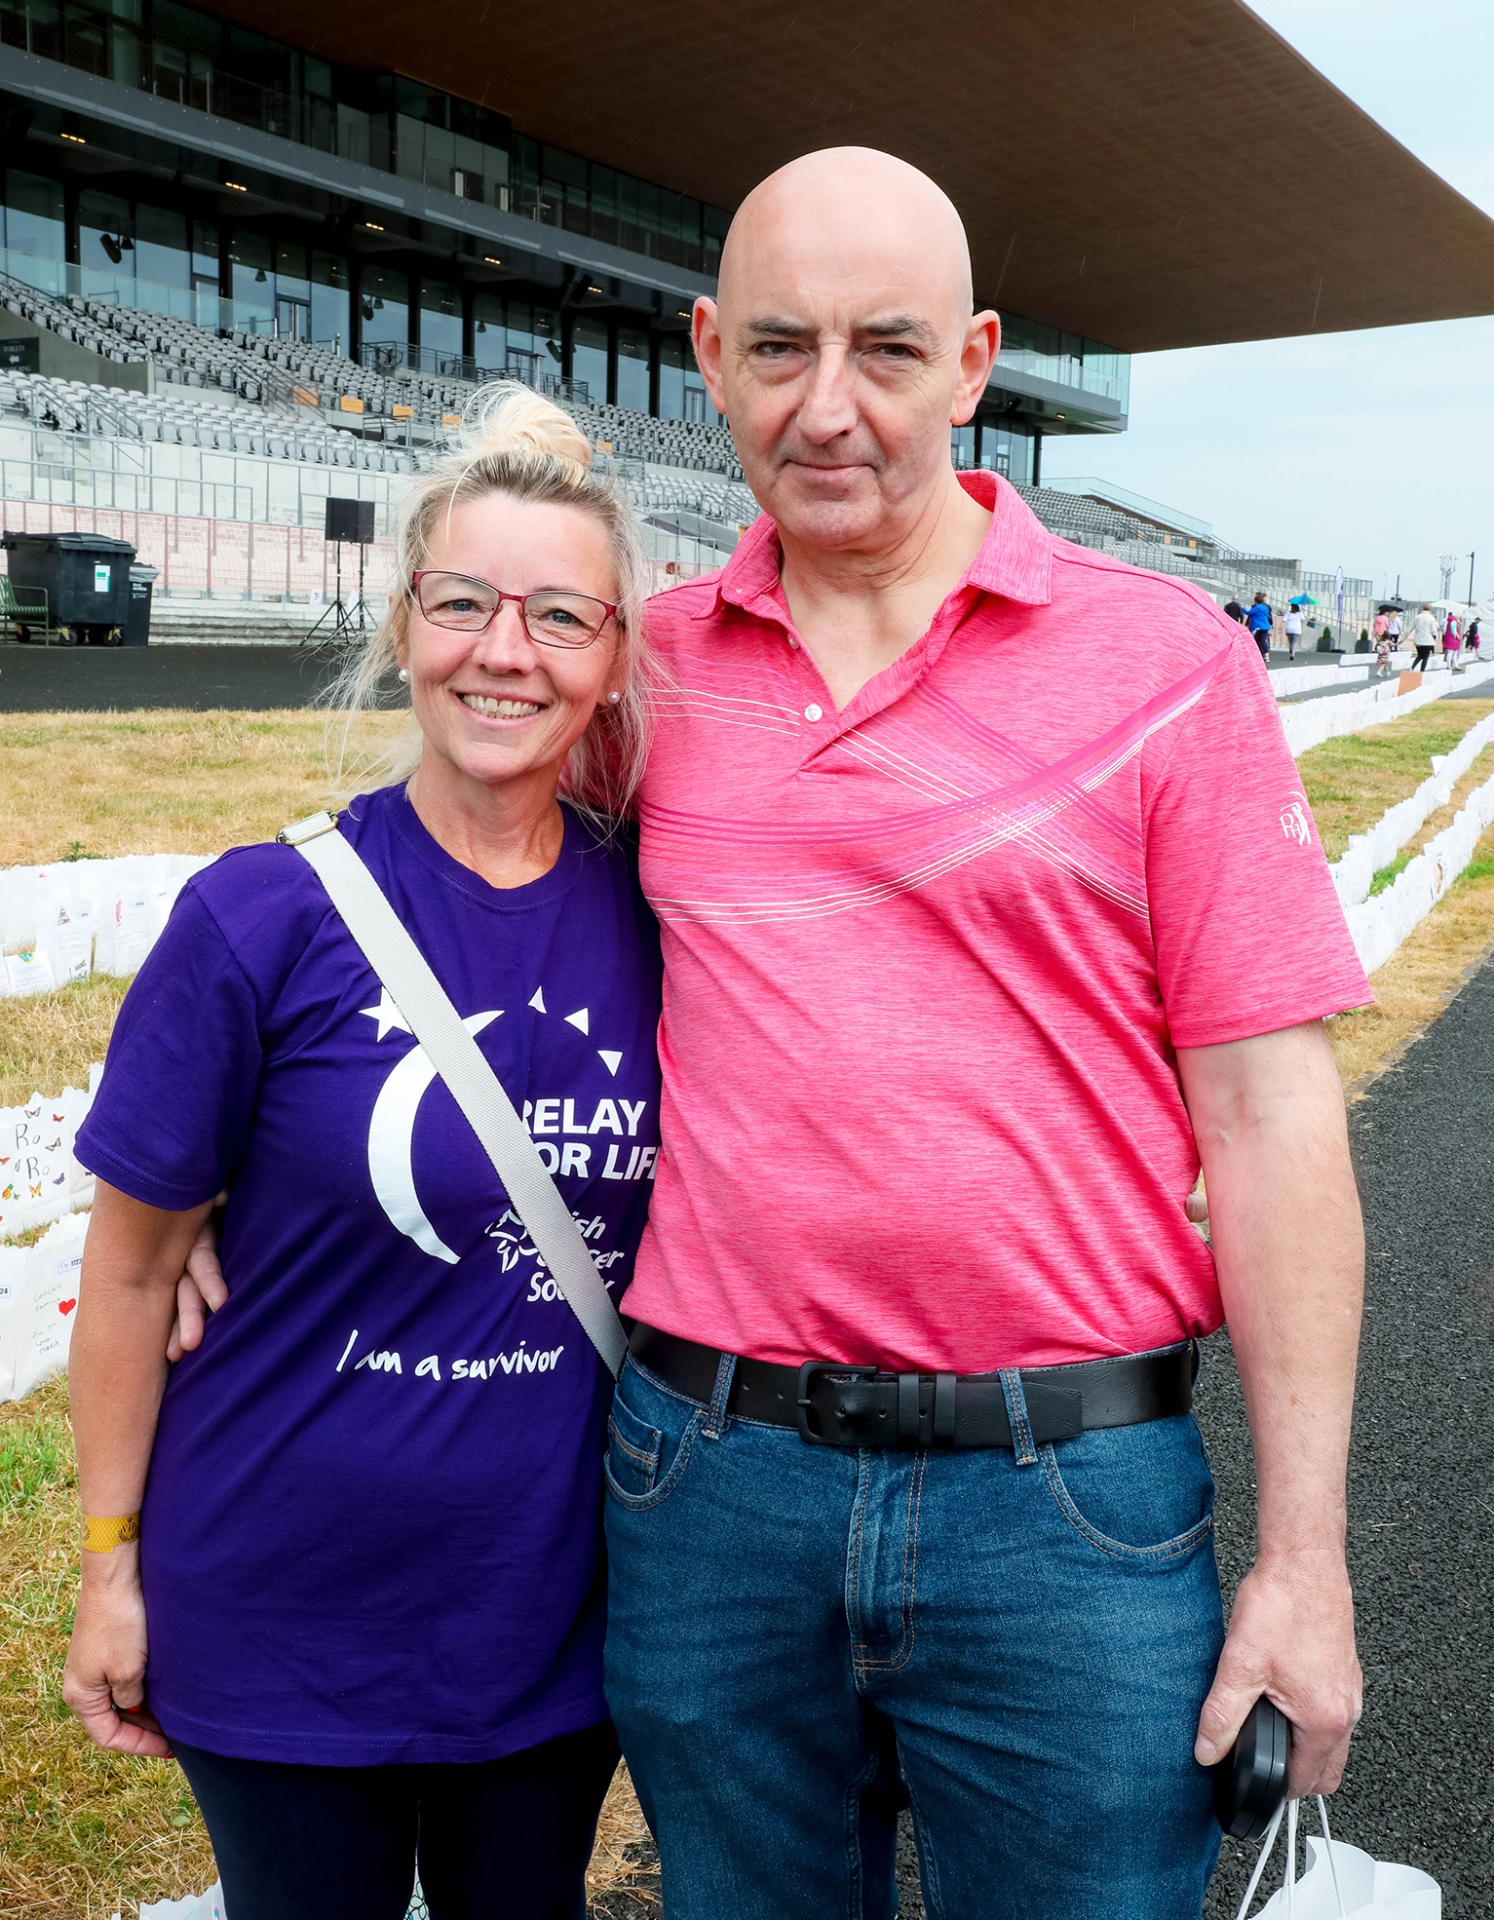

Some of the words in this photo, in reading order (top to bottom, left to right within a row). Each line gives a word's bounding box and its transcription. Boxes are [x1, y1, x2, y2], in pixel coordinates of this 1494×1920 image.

[15, 1123, 41, 1150] Ro
[26, 1156, 50, 1180] Ro
[533, 1141, 592, 1178] OR
[336, 1329, 358, 1372] I
[354, 1350, 402, 1374] am
[415, 1355, 441, 1381] a
[452, 1340, 564, 1380] survivor
